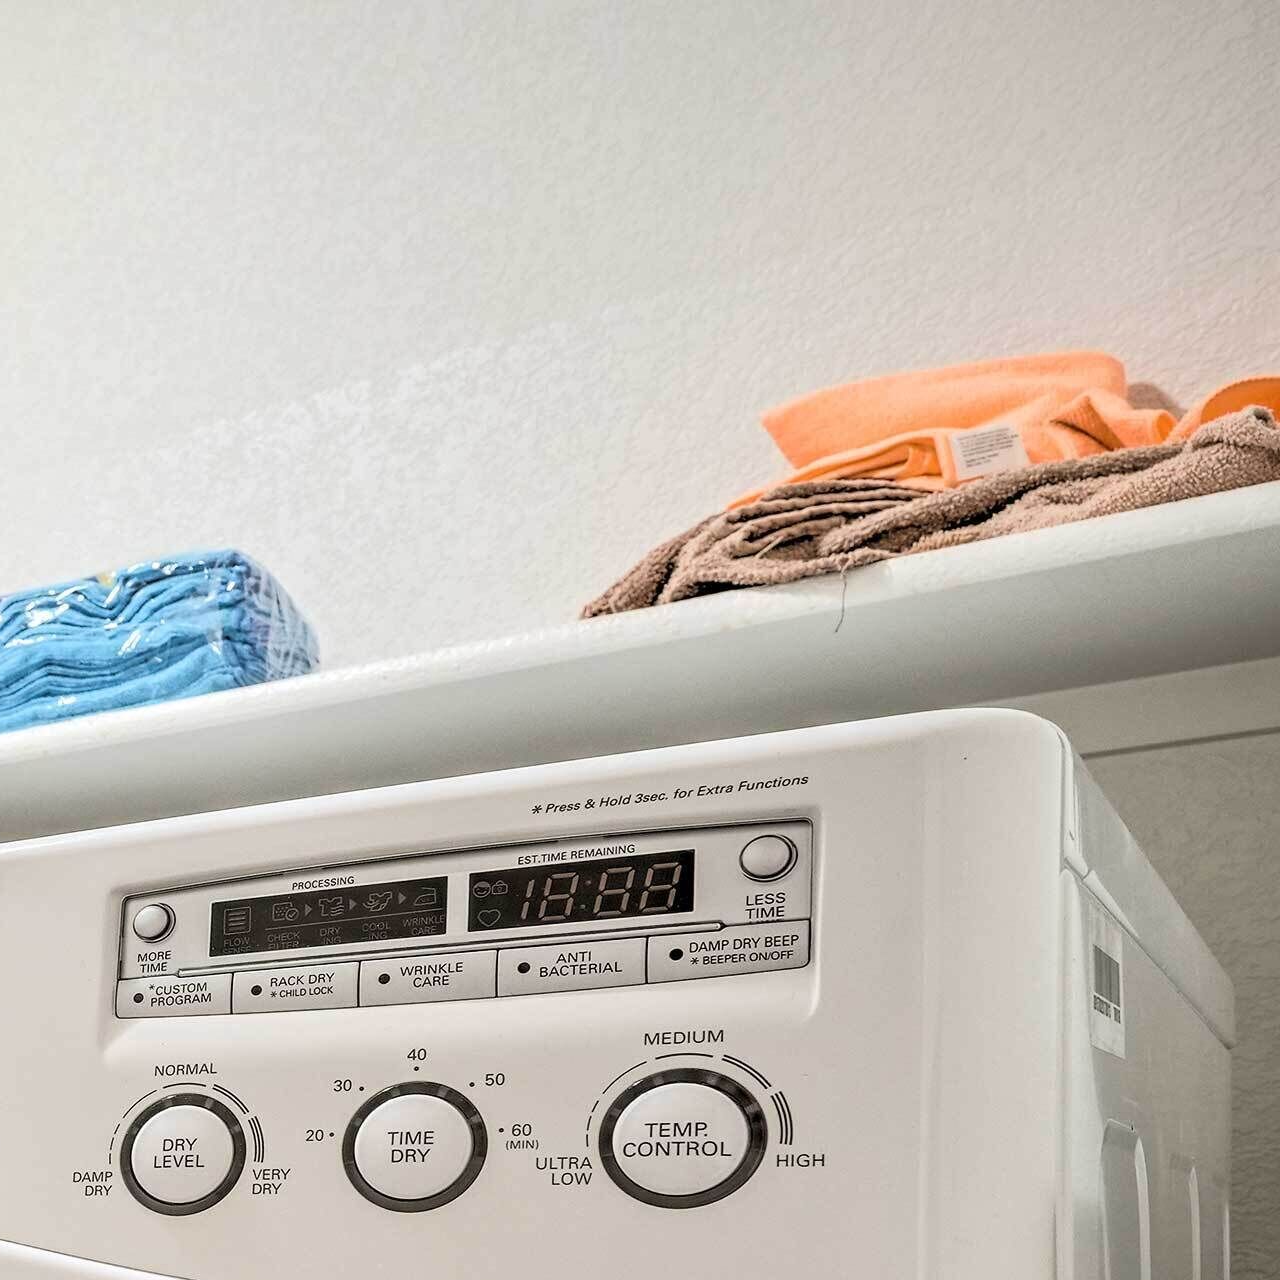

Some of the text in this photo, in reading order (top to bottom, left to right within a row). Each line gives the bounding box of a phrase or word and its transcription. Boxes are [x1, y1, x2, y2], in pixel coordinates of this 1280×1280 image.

[545, 776, 809, 815] Press & Hold 3sec. for Extra Functions
[570, 844, 636, 860] REMAINING
[292, 876, 355, 891] PROCESSING
[746, 892, 786, 906] LESS
[745, 906, 785, 919] TIME
[362, 921, 391, 932] COOL
[403, 914, 446, 928] WRINKLE
[268, 931, 300, 942] CHECK
[320, 927, 341, 937] DRY
[411, 925, 437, 936] CARE
[689, 934, 799, 954] DAMP DRY BEEP
[137, 950, 172, 963] MORE
[556, 951, 592, 964] ANTI
[702, 950, 794, 965] BEEPER ON/OFF
[139, 961, 167, 974] TIME
[400, 962, 464, 978] WRINKLE
[539, 961, 622, 978] BACTERIAL
[270, 972, 335, 988] RACK DRY
[413, 975, 450, 989] CARE
[150, 992, 212, 1007] PROGRAM
[279, 986, 334, 999] CHILD LOCK
[644, 1029, 725, 1046] MEDIUM
[407, 1048, 427, 1061] 40
[154, 1063, 217, 1077] NORMAL
[333, 1079, 352, 1092] 30
[485, 1073, 505, 1086] 50
[305, 1129, 324, 1142] 20
[511, 1124, 532, 1137] 60
[644, 1122, 708, 1138] TEMP.
[163, 1138, 197, 1152] DRY
[387, 1130, 435, 1146] TIME
[505, 1139, 539, 1151] (MIN)
[390, 1148, 431, 1163] DRY
[623, 1141, 732, 1158] CONTROL
[153, 1155, 205, 1169] LEVEL
[536, 1156, 593, 1171] ULTRA
[776, 1153, 825, 1168] HIGH
[72, 1171, 113, 1184] DAMP
[252, 1168, 291, 1181] VERY
[551, 1172, 592, 1186] LOW
[84, 1185, 113, 1197] DRY
[251, 1183, 282, 1195] DRY
